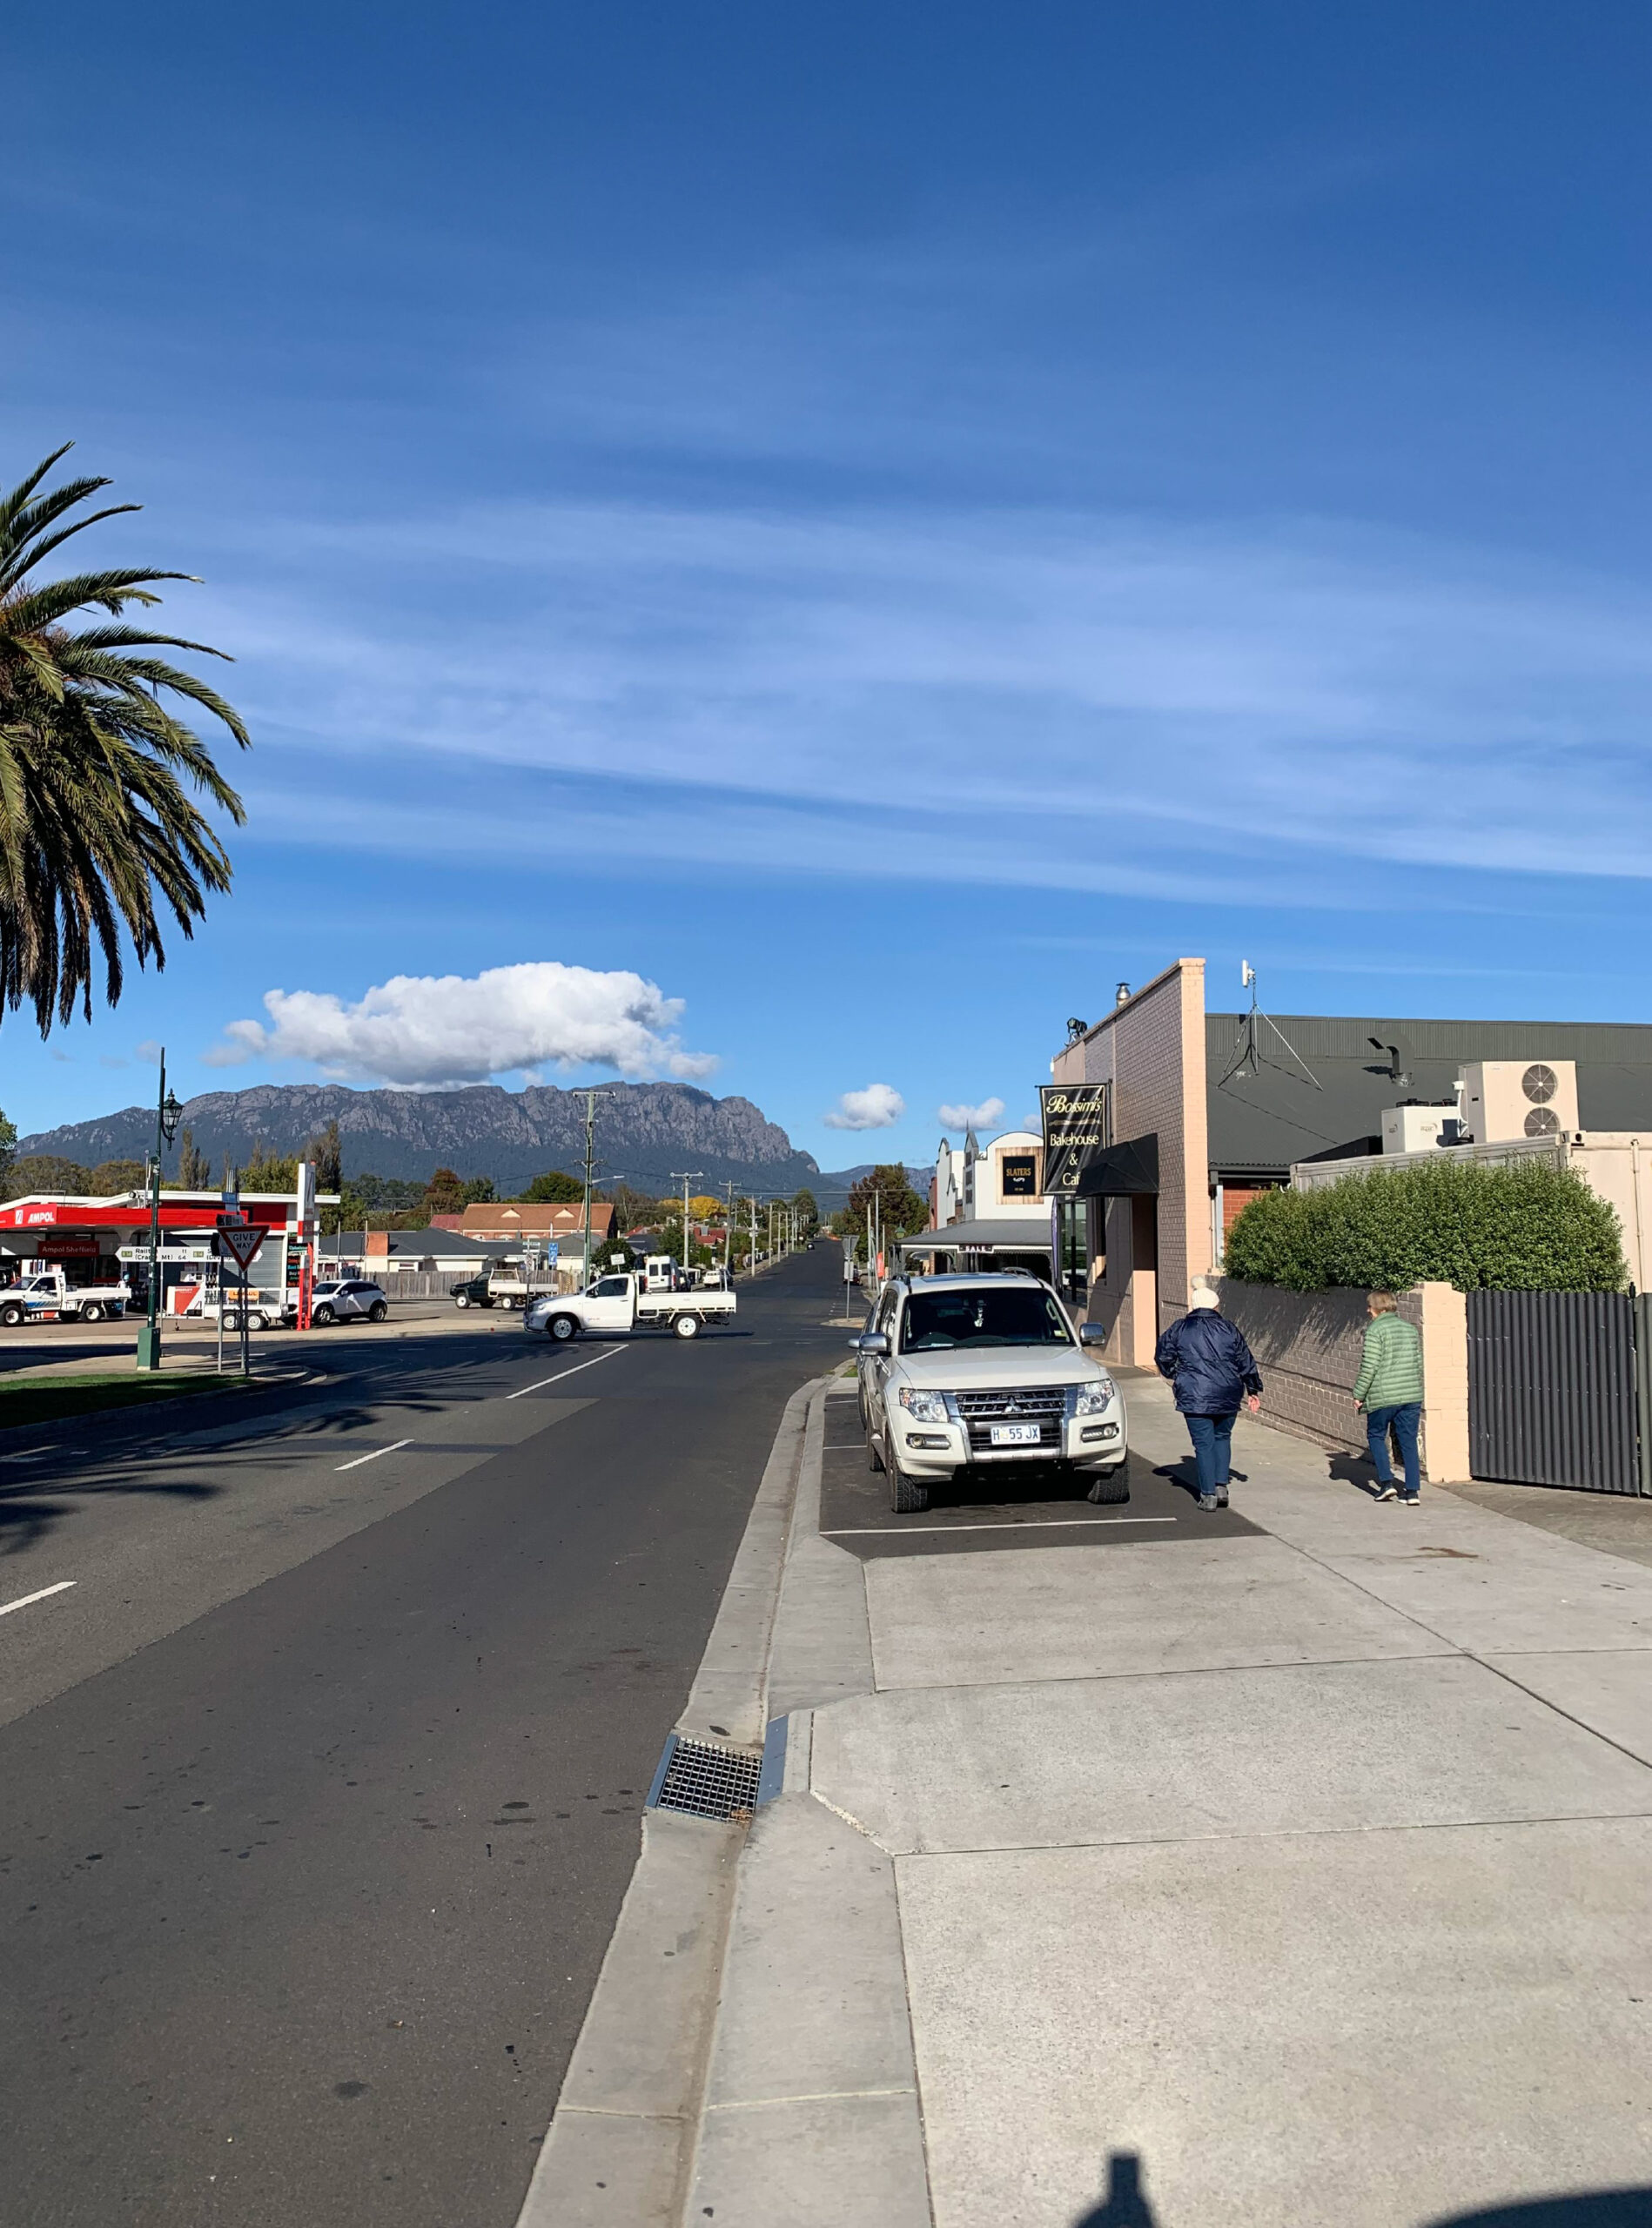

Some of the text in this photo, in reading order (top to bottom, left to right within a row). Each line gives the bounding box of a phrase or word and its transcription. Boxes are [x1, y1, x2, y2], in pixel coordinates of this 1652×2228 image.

[1050, 1132, 1099, 1147] Bakehouse
[1069, 1153, 1078, 1166] &
[1006, 1167, 1031, 1177] SLATERS
[1062, 1171, 1081, 1186] Caf
[28, 1211, 55, 1224] AMPOL
[232, 1232, 255, 1241] GIVE
